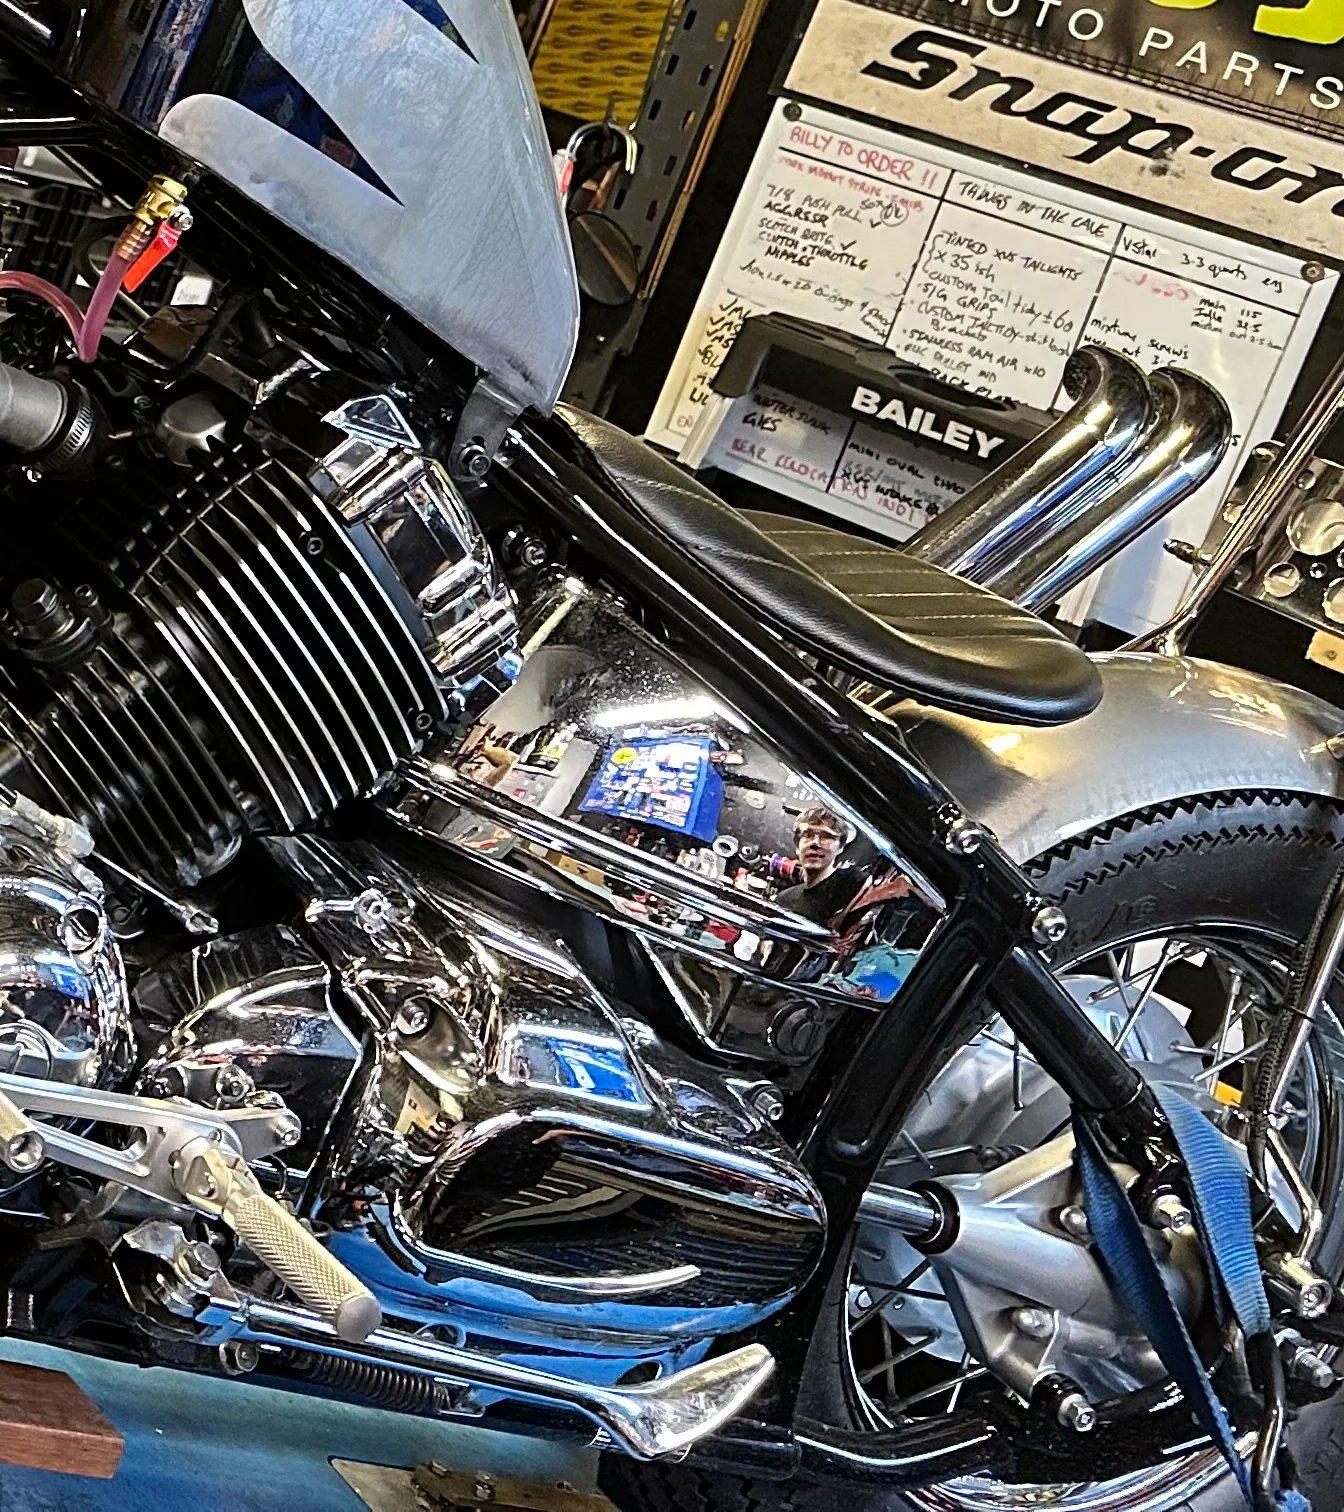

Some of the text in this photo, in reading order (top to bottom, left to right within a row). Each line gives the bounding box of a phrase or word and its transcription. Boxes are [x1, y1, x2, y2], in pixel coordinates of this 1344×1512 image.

[1138, 28, 1344, 110] PARTS
[789, 125, 833, 151] BILLY
[837, 141, 854, 156] TO
[857, 149, 915, 182] ORDER
[766, 184, 795, 202] 7/8
[958, 180, 1012, 211] THINGS
[1036, 205, 1070, 225] THE
[950, 253, 974, 272] 35
[956, 295, 999, 320] GRIPS
[851, 386, 1004, 459] BAILEY
